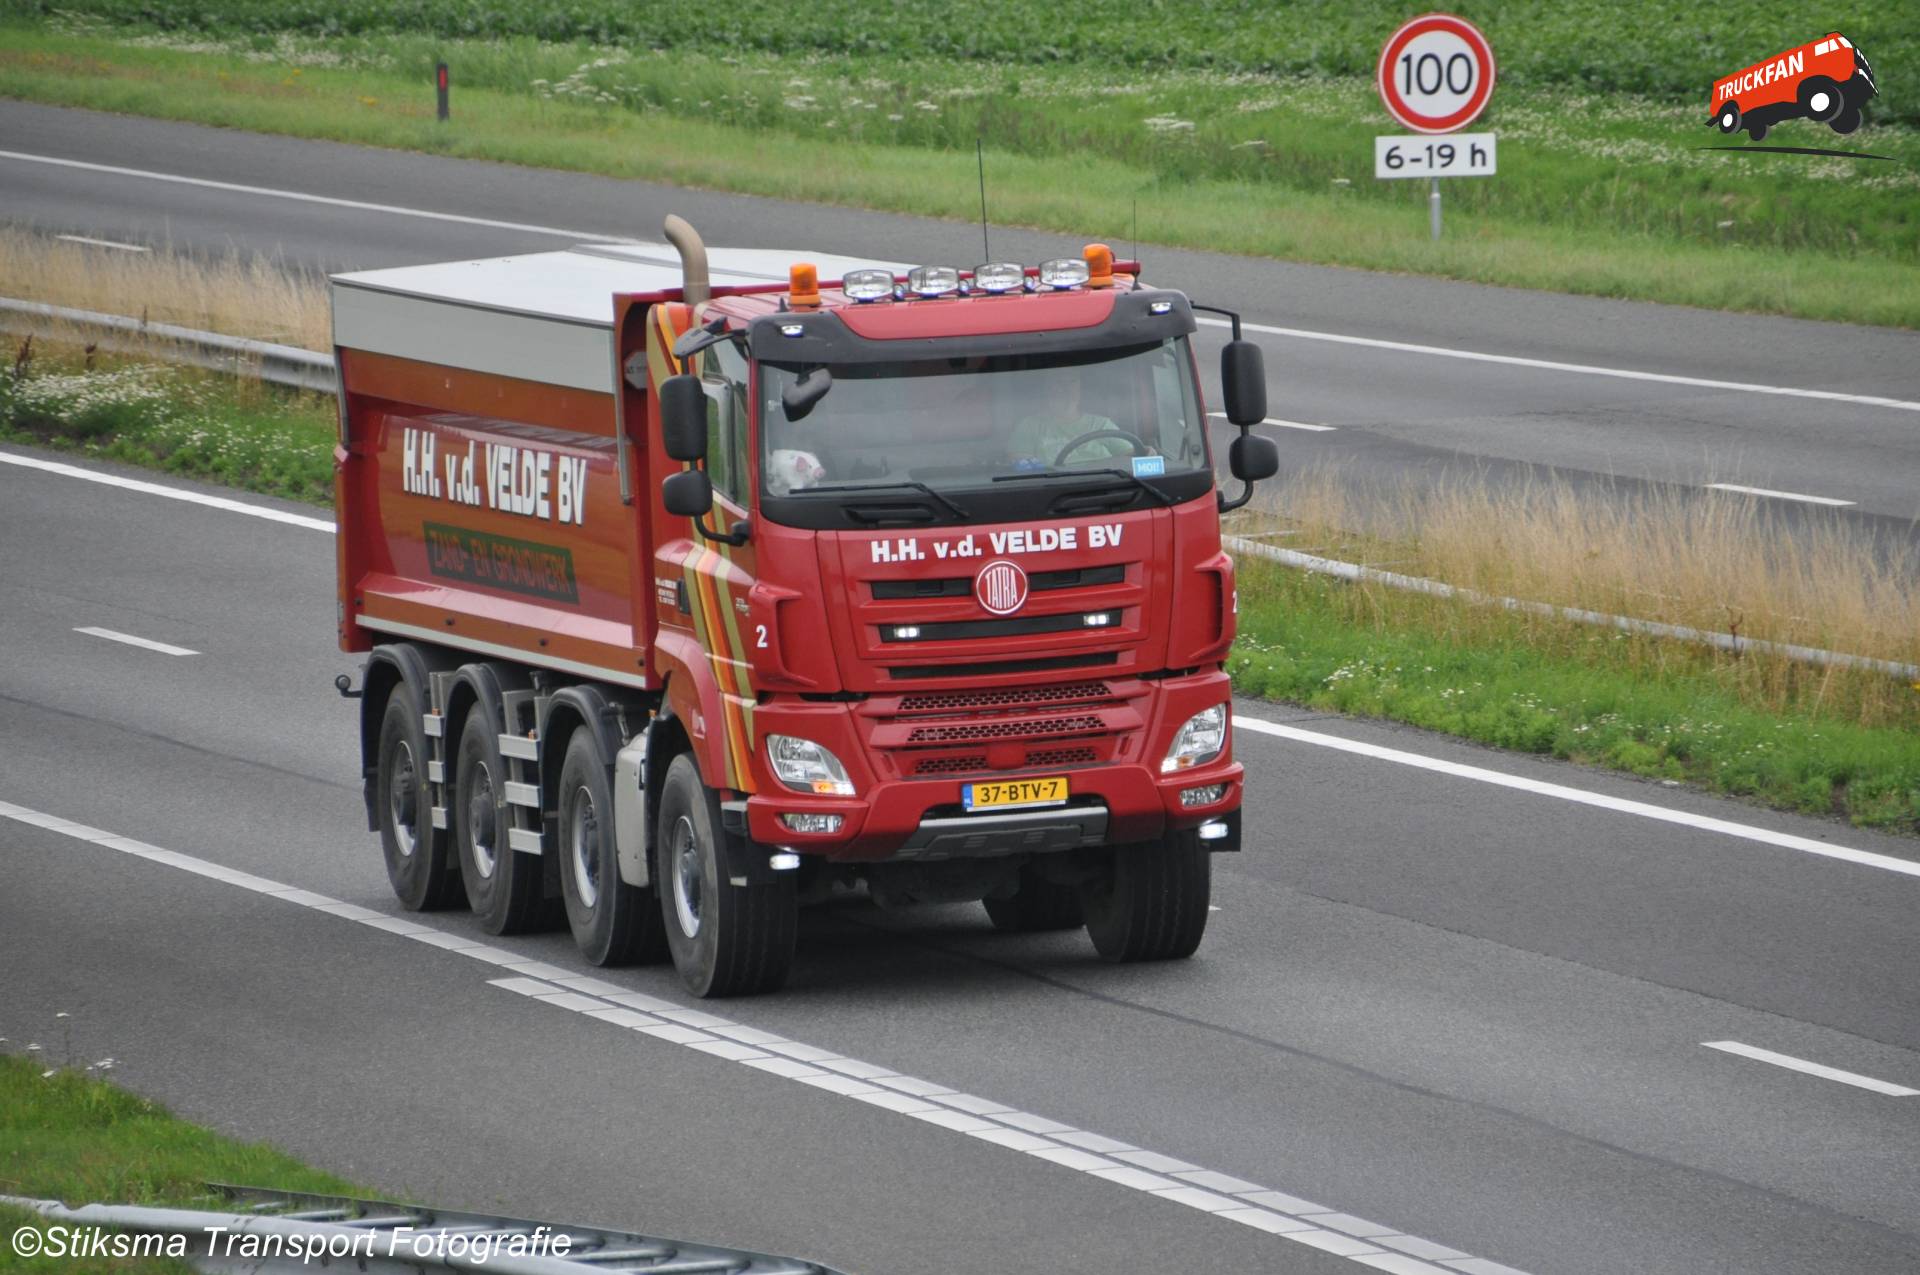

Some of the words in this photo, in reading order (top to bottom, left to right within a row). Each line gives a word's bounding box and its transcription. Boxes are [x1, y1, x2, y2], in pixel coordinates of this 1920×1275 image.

[1400, 52, 1474, 96] 100
[1384, 143, 1456, 170] 6-19
[1470, 142, 1487, 168] h
[403, 427, 440, 498] H.H.
[445, 439, 480, 506] v.d.
[485, 443, 550, 520] VELDE
[558, 455, 587, 526] BV
[871, 538, 925, 563] H.H.
[933, 534, 982, 559] v.d.
[989, 527, 1077, 554] VELDE
[1088, 524, 1123, 548] BV
[984, 566, 1018, 609] TATRA
[756, 624, 768, 648] 2
[981, 781, 1058, 803] 37-BTV-7
